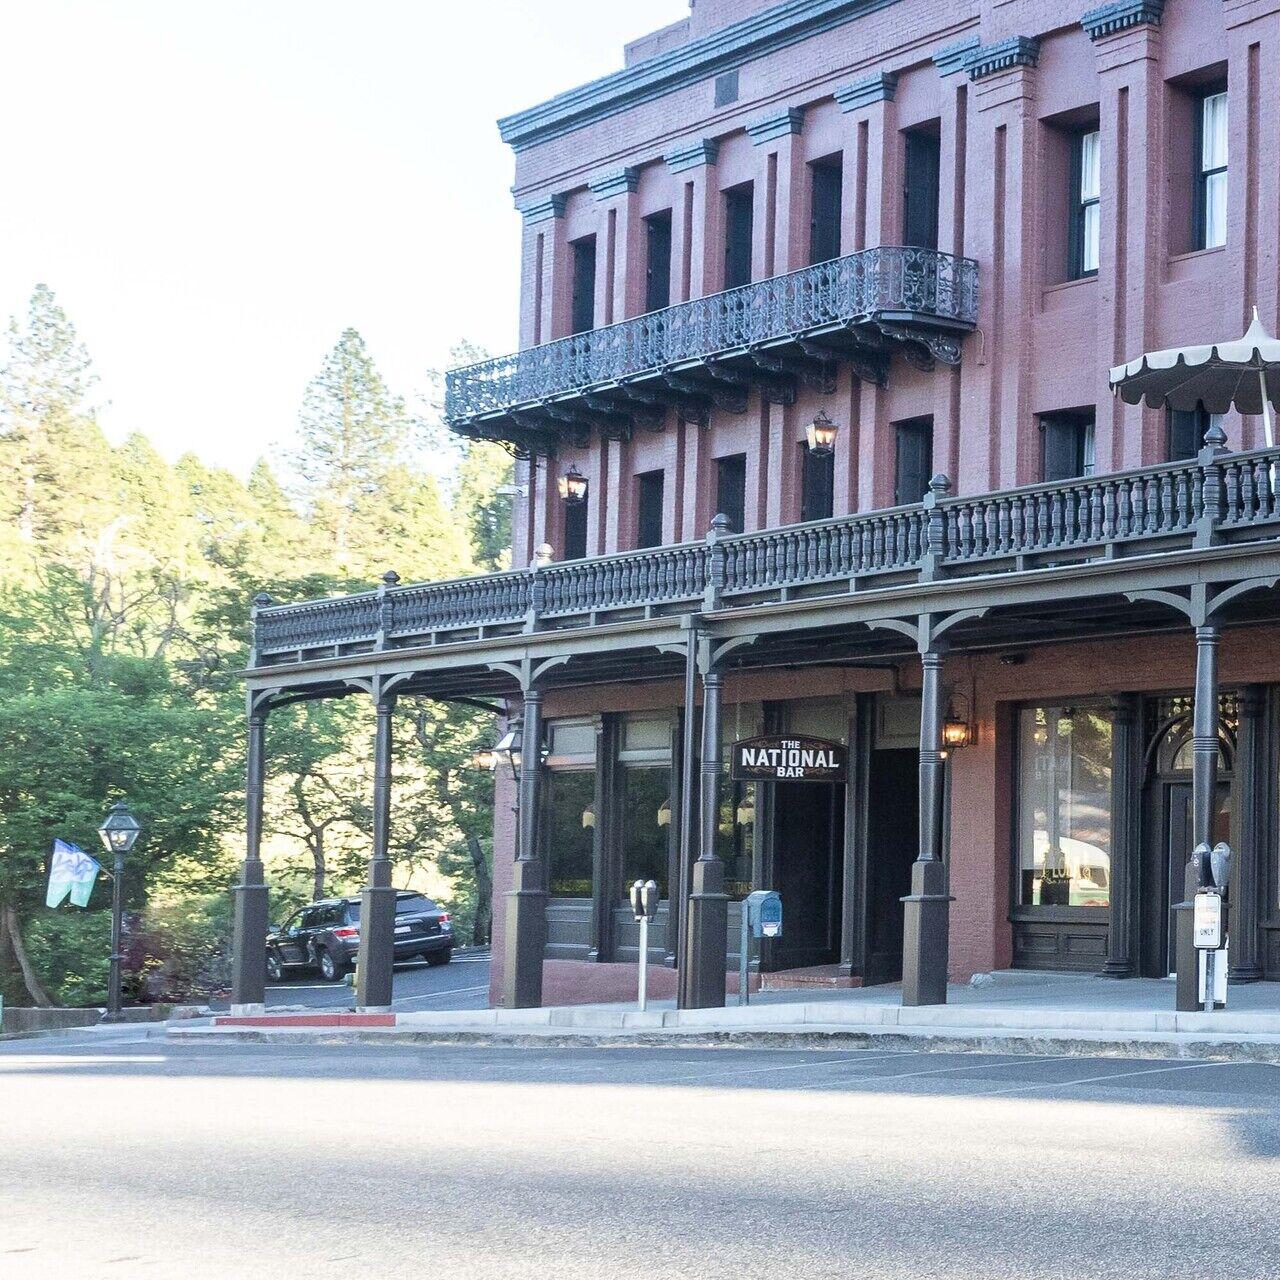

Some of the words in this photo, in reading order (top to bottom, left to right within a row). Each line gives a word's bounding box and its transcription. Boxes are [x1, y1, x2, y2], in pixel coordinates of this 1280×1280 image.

[781, 740, 801, 749] THE
[742, 748, 840, 768] NATIONAL
[777, 766, 804, 778] BAR
